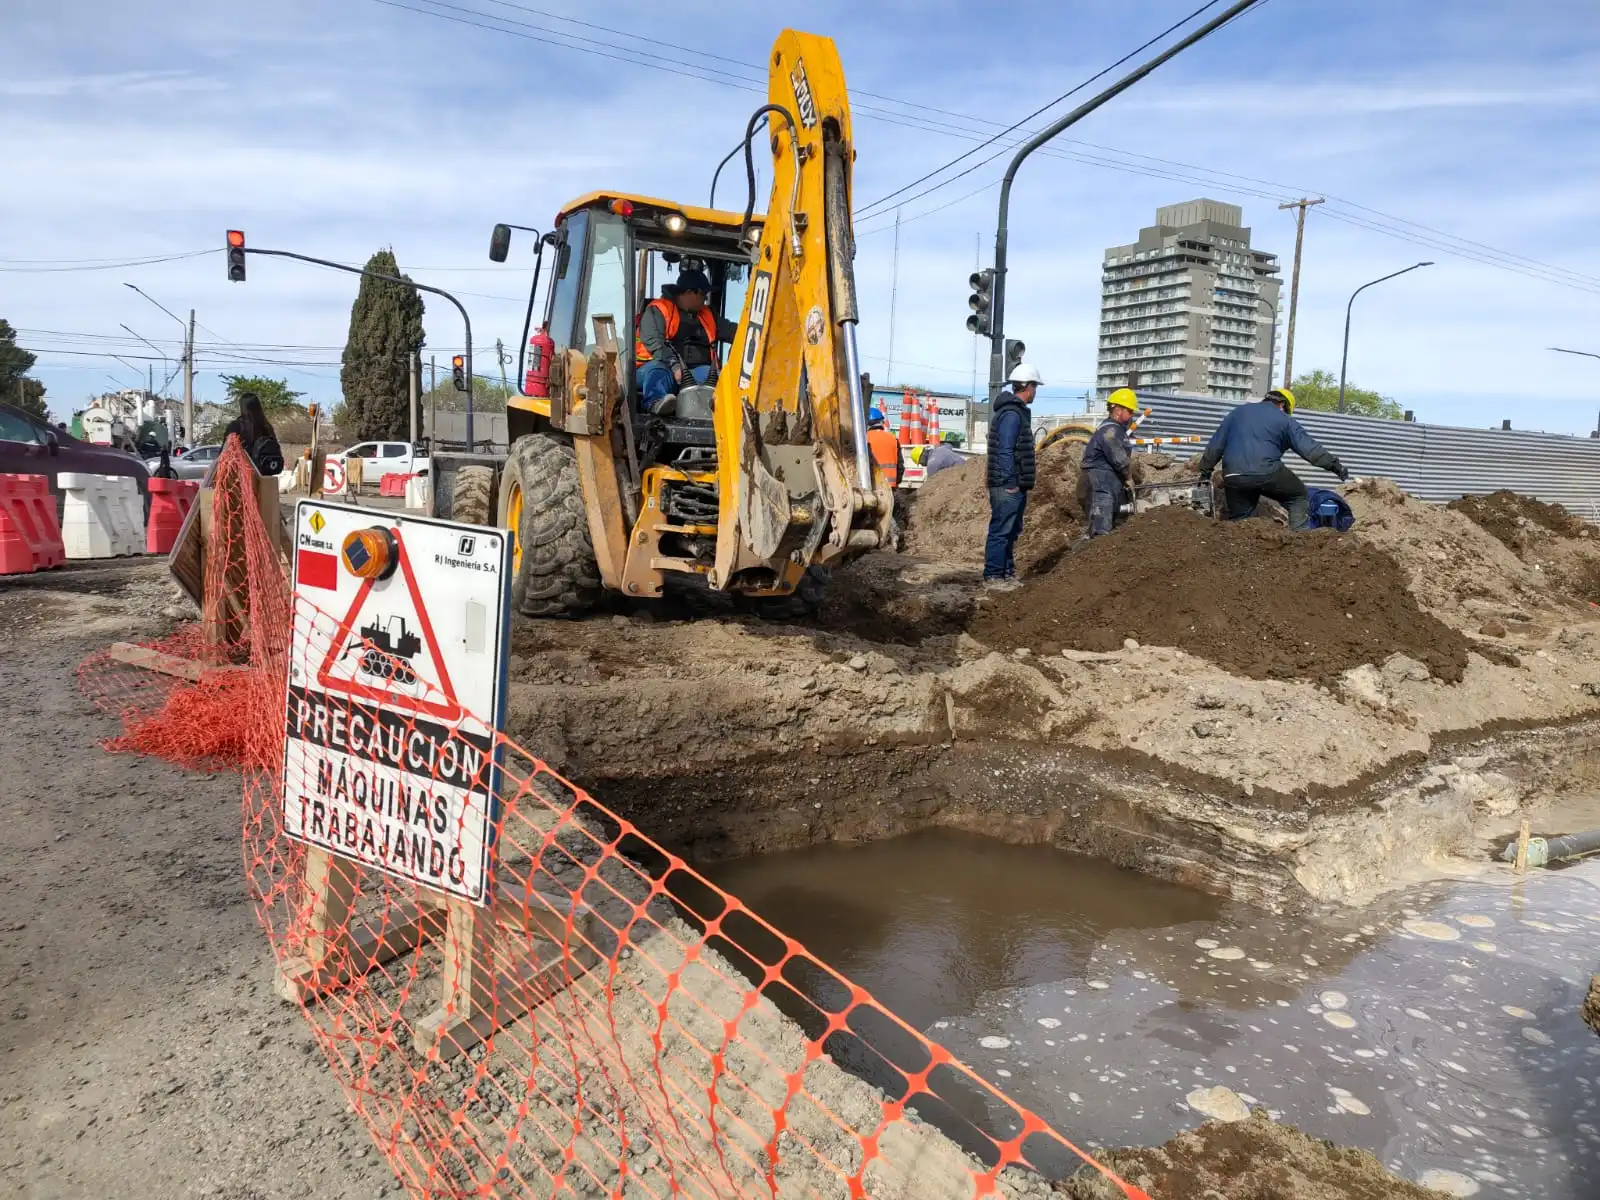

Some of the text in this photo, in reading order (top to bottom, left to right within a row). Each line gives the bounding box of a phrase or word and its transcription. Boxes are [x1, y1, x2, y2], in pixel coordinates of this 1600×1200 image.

[434, 554, 443, 565] RJ
[317, 757, 448, 834] MÁQUINAS
[298, 795, 465, 885] TRABAJANDO
